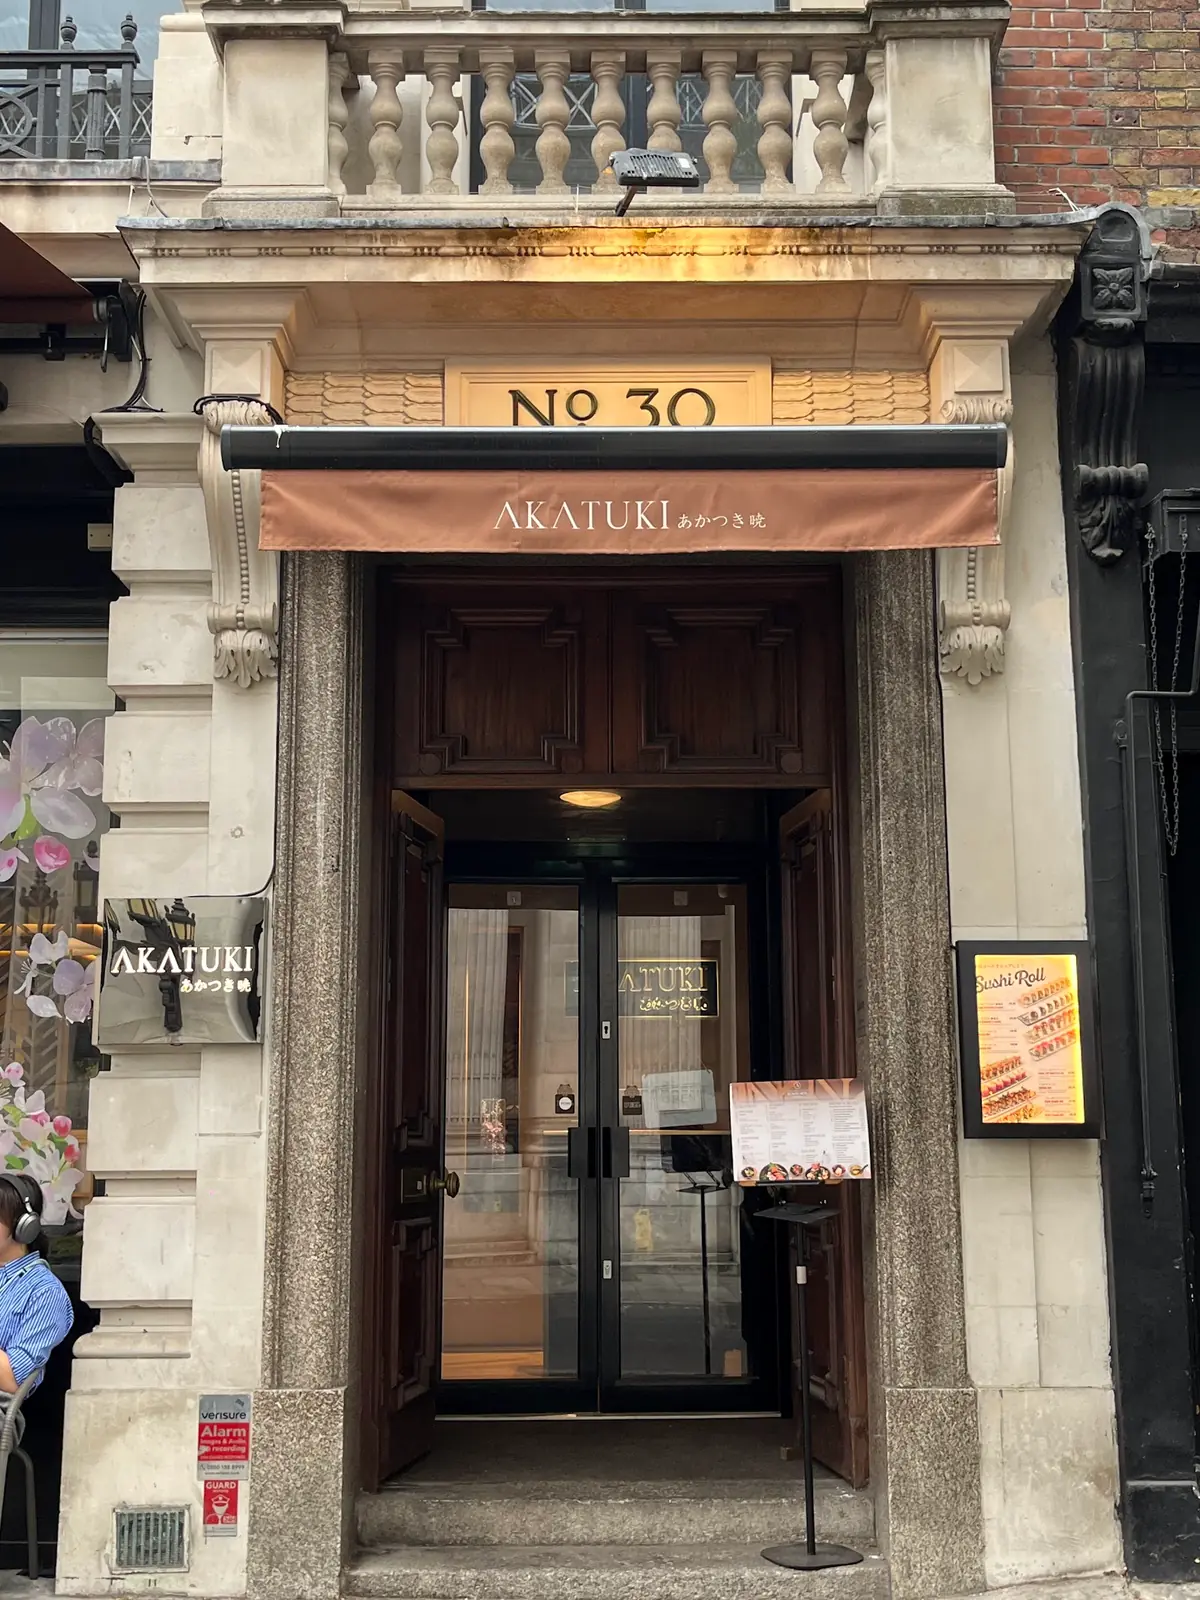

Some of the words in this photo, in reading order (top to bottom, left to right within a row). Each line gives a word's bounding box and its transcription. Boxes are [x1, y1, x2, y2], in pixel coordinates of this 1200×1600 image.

[626, 388, 716, 426] 30
[493, 500, 669, 530] AKATUKI
[677, 512, 767, 529] あかつき暁
[110, 946, 254, 974] AKATUKI
[975, 971, 1013, 993] Sushi
[1014, 967, 1046, 987] Roll
[201, 1411, 247, 1420] verisure
[201, 1425, 247, 1437] Alarm
[212, 1445, 246, 1454] recording
